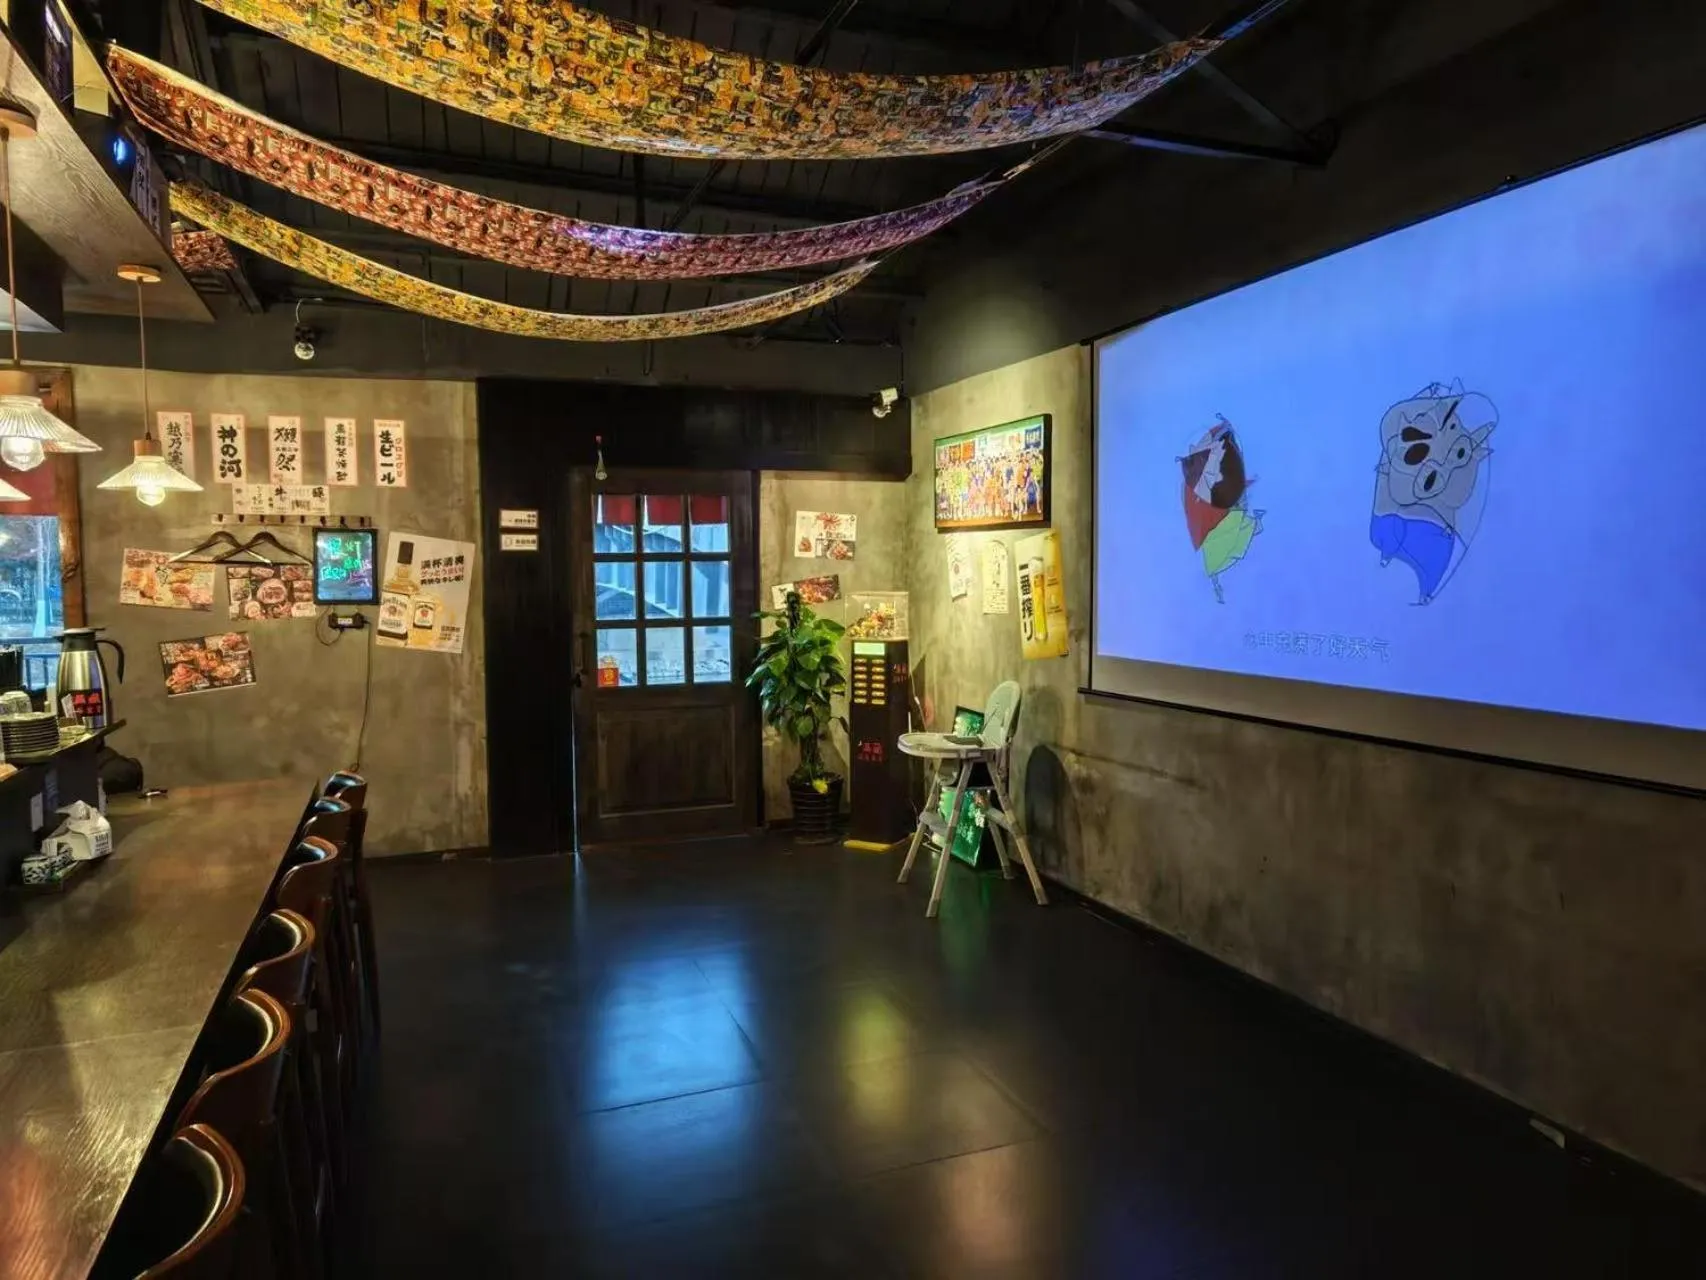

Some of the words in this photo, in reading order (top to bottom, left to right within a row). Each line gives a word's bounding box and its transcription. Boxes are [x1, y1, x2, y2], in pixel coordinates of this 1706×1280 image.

[217, 425, 242, 478] 神の河
[379, 429, 396, 485] 生ビール
[1019, 563, 1034, 641] 一番搾り
